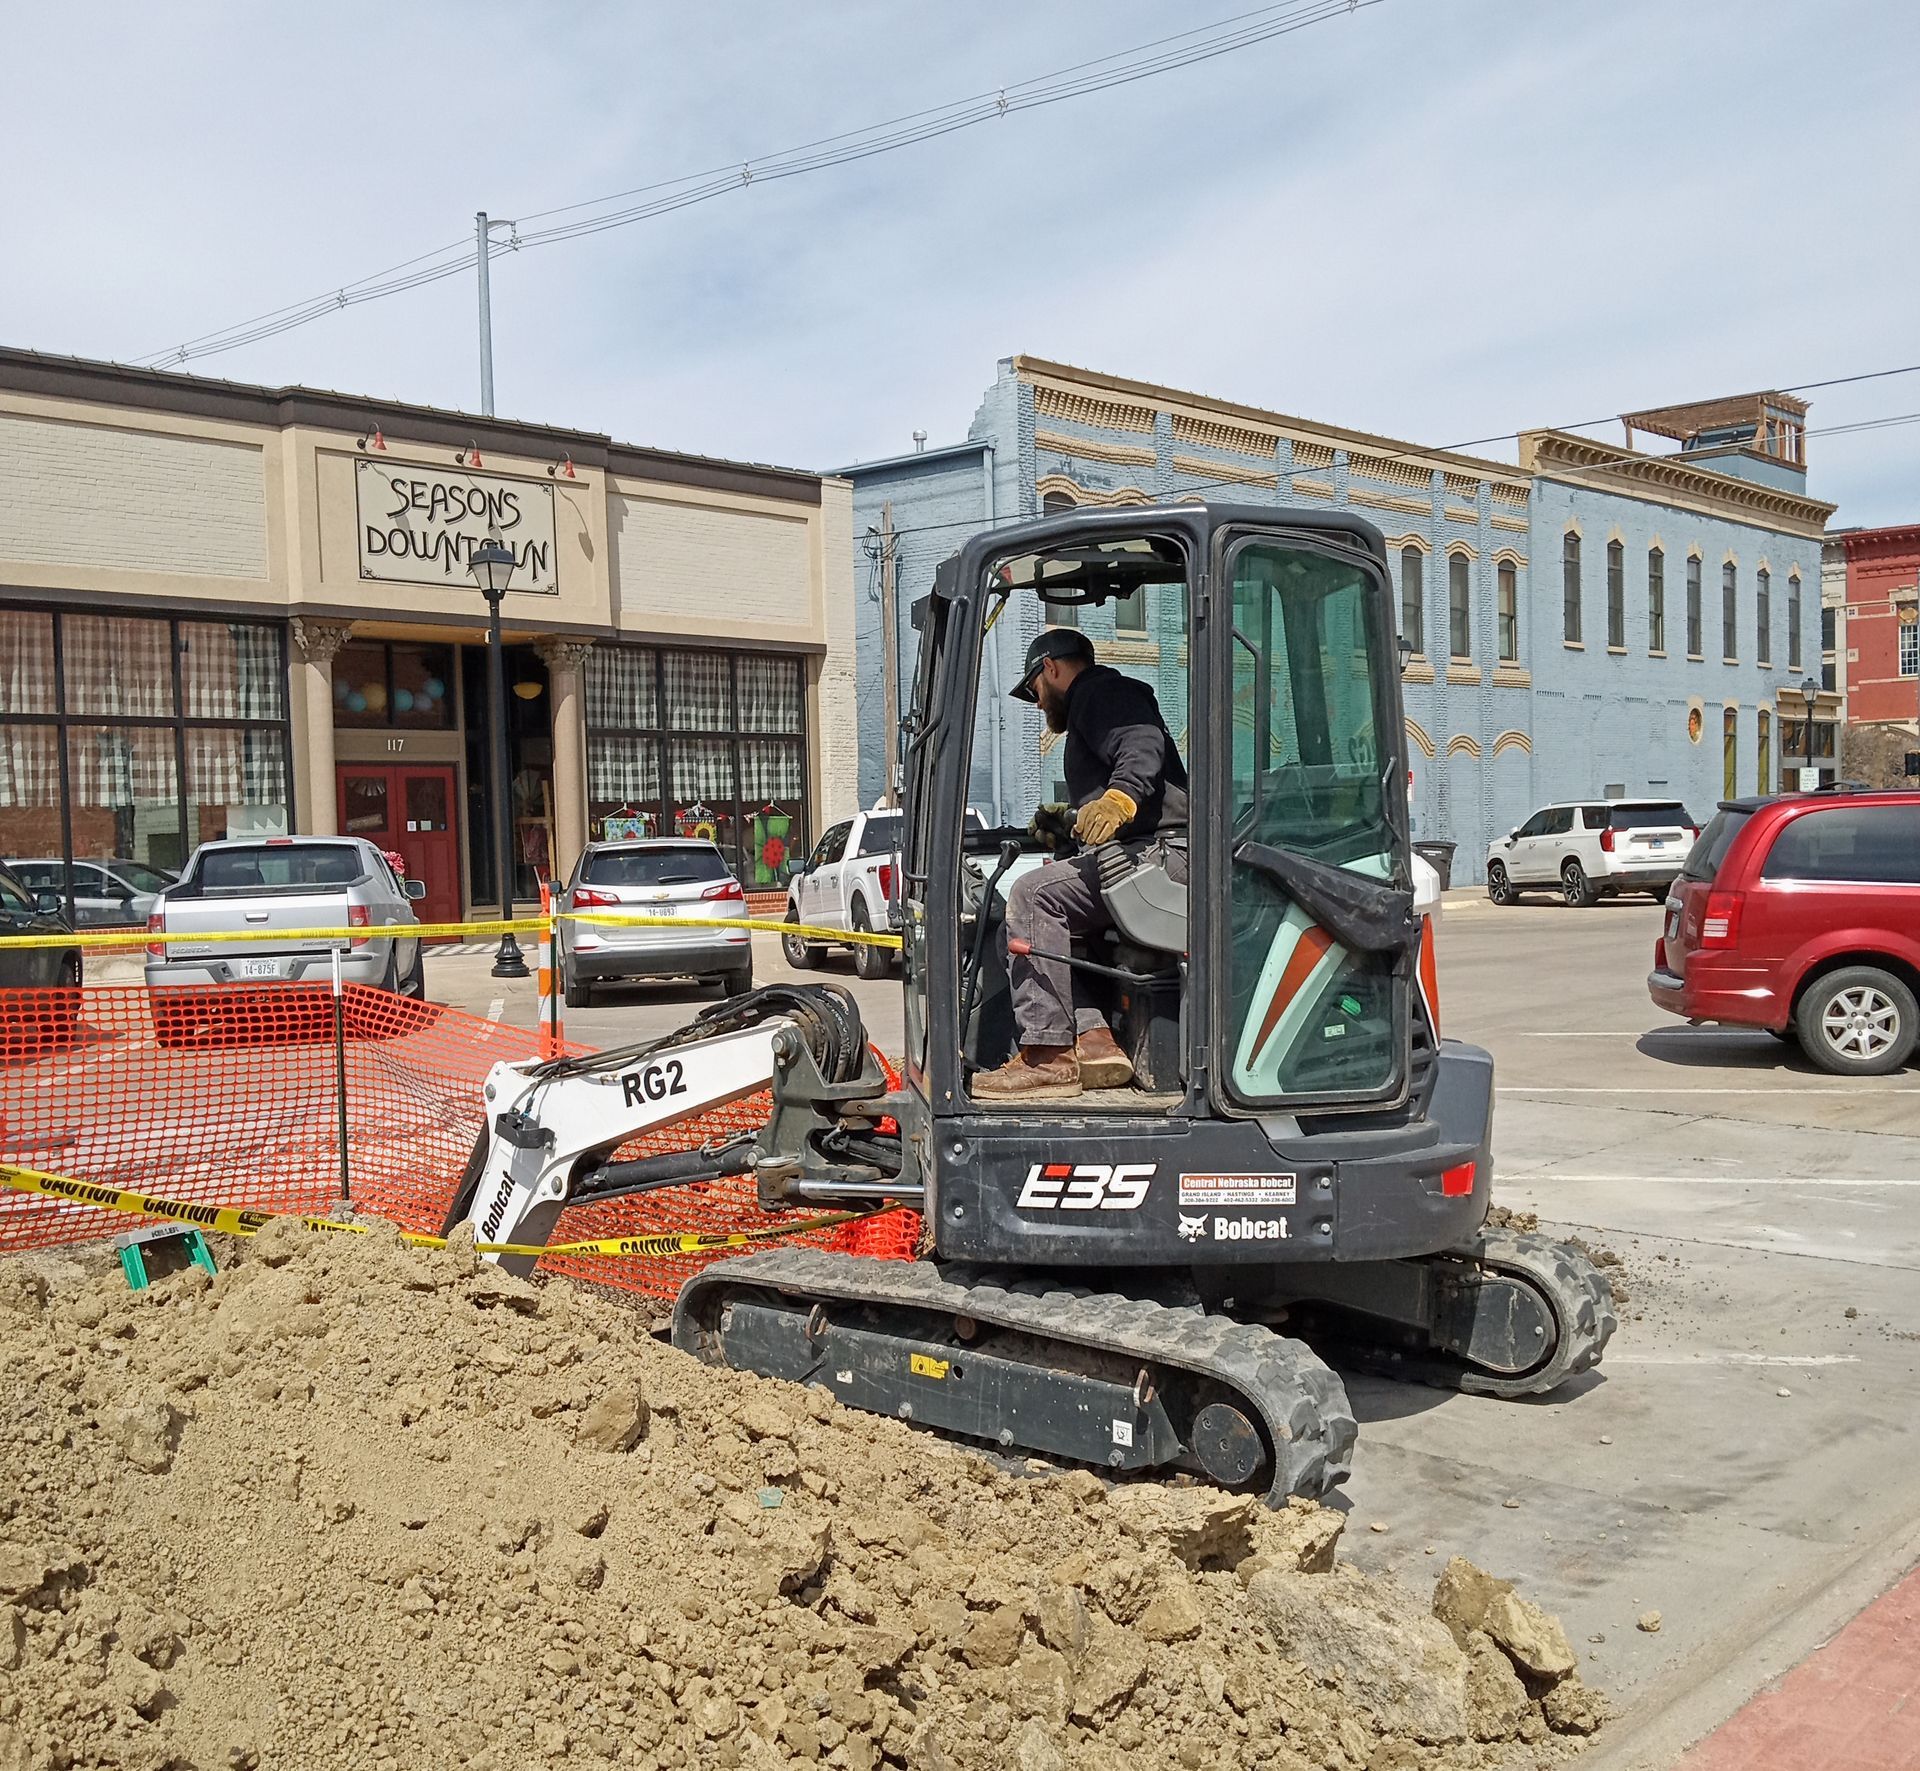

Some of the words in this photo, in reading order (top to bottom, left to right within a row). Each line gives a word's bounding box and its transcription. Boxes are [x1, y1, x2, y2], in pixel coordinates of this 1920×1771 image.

[386, 478, 522, 531] SEASONS
[387, 739, 404, 752] 117
[171, 945, 213, 955] HONDA
[621, 1060, 687, 1108] RG2
[40, 1177, 121, 1205] CAUTION
[1016, 1163, 1158, 1210] E35
[1183, 1177, 1217, 1188] Central
[1217, 1177, 1259, 1188] Nebraska
[1260, 1177, 1292, 1188] Bobcat
[143, 1197, 221, 1225] CAUTION
[481, 1170, 516, 1243] Bobcat
[151, 1226, 179, 1238] KELLER
[619, 1236, 682, 1255] CAUTION
